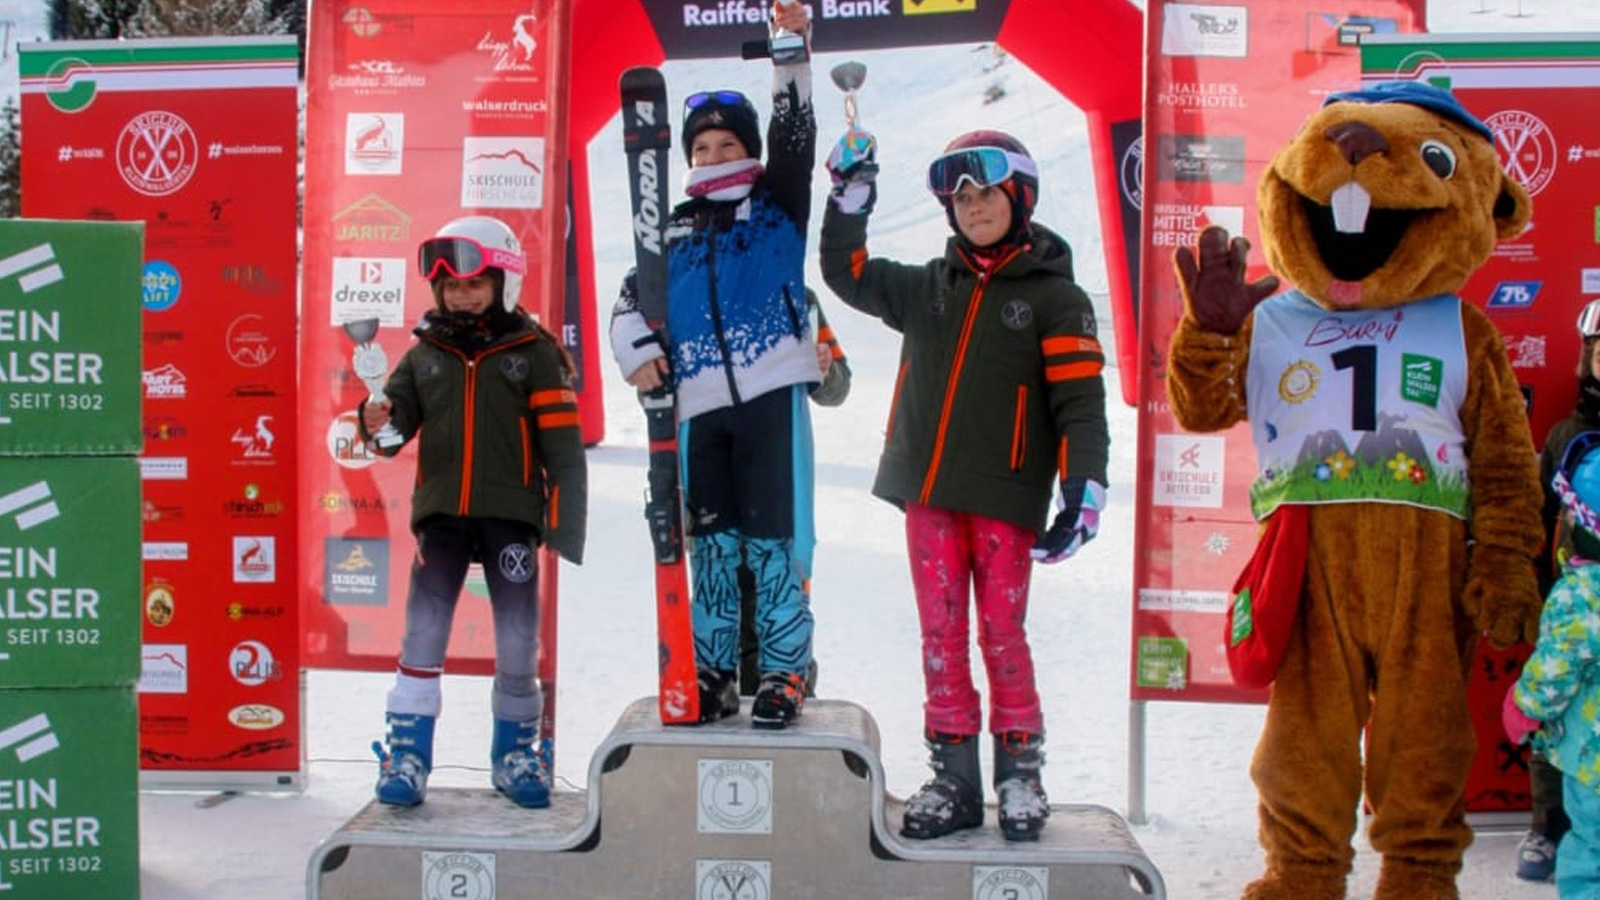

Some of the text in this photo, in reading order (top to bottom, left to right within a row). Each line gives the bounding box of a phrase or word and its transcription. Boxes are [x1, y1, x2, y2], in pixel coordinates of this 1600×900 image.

[822, 0, 890, 19] Bank
[462, 99, 547, 113] walserdruck
[1487, 113, 1545, 137] KICLUB
[1153, 215, 1197, 231] MITTEL
[335, 284, 401, 304] drexel
[1330, 344, 1378, 432] 1
[10, 393, 103, 411] SEIT 1302
[0, 588, 100, 620] LSER
[7, 628, 100, 645] SEIT 1302
[727, 781, 743, 806] 1
[9, 857, 101, 874] SEIT 1302
[450, 873, 468, 898] 2
